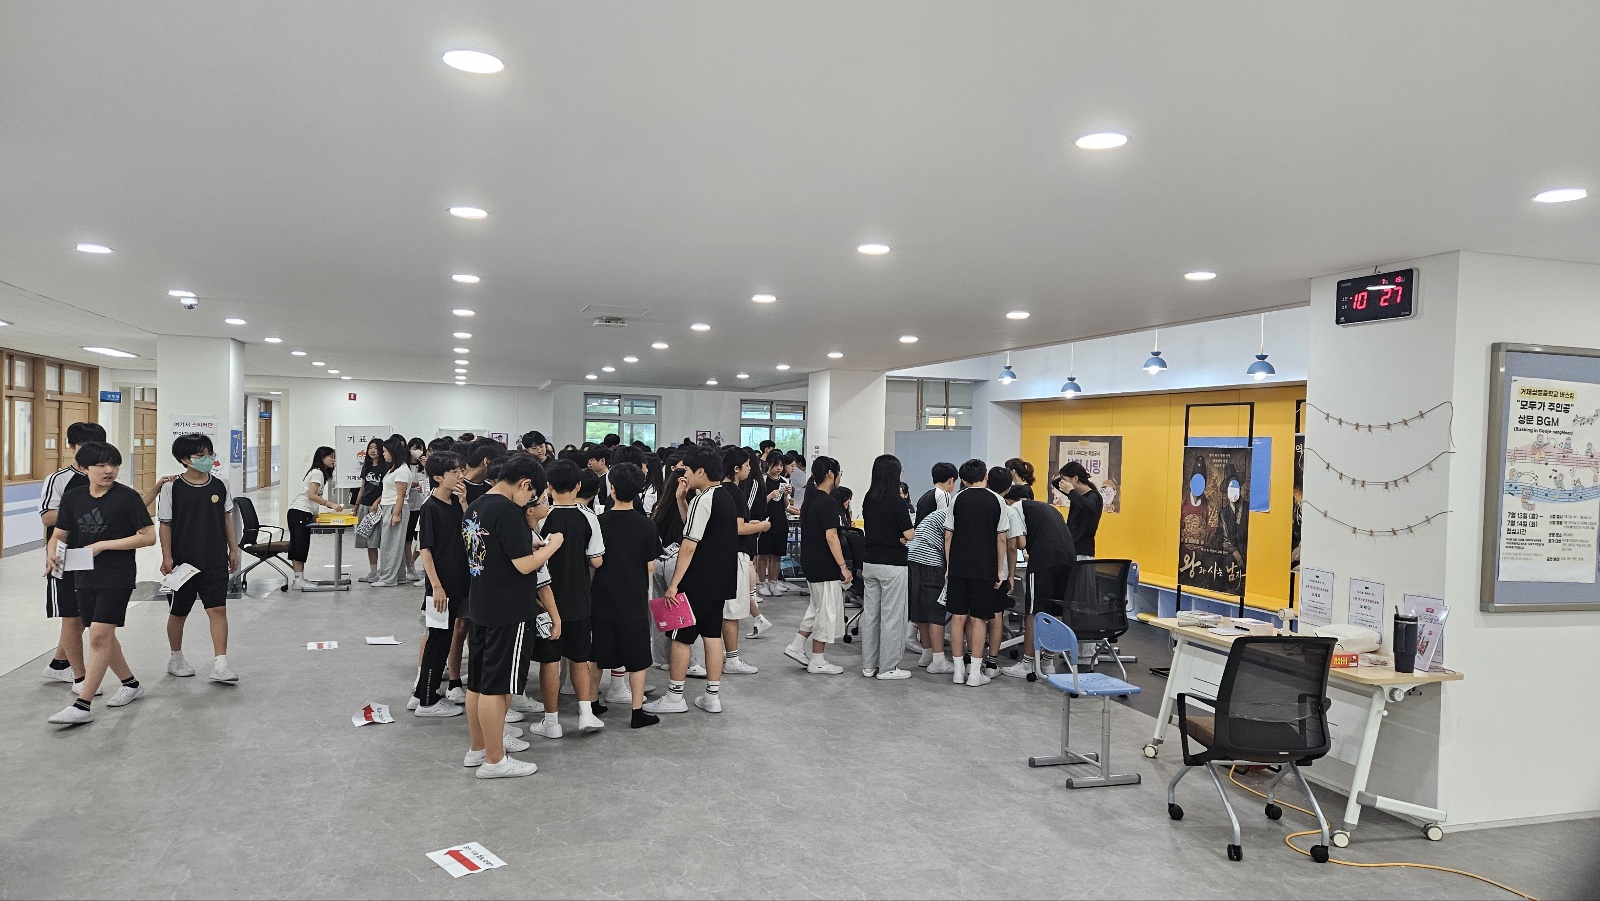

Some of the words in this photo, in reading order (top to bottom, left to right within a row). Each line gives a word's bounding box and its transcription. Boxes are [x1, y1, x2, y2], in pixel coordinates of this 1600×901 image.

[1353, 291, 1368, 309] 10
[1380, 286, 1402, 306] 27
[1517, 400, 1545, 411] "모두가
[1548, 402, 1574, 413] 주인공"
[1518, 415, 1534, 424] 상문
[1537, 416, 1559, 426] BGM
[1179, 551, 1206, 578] 왕과
[1208, 561, 1223, 580] 사는
[1226, 562, 1246, 590] 남자
